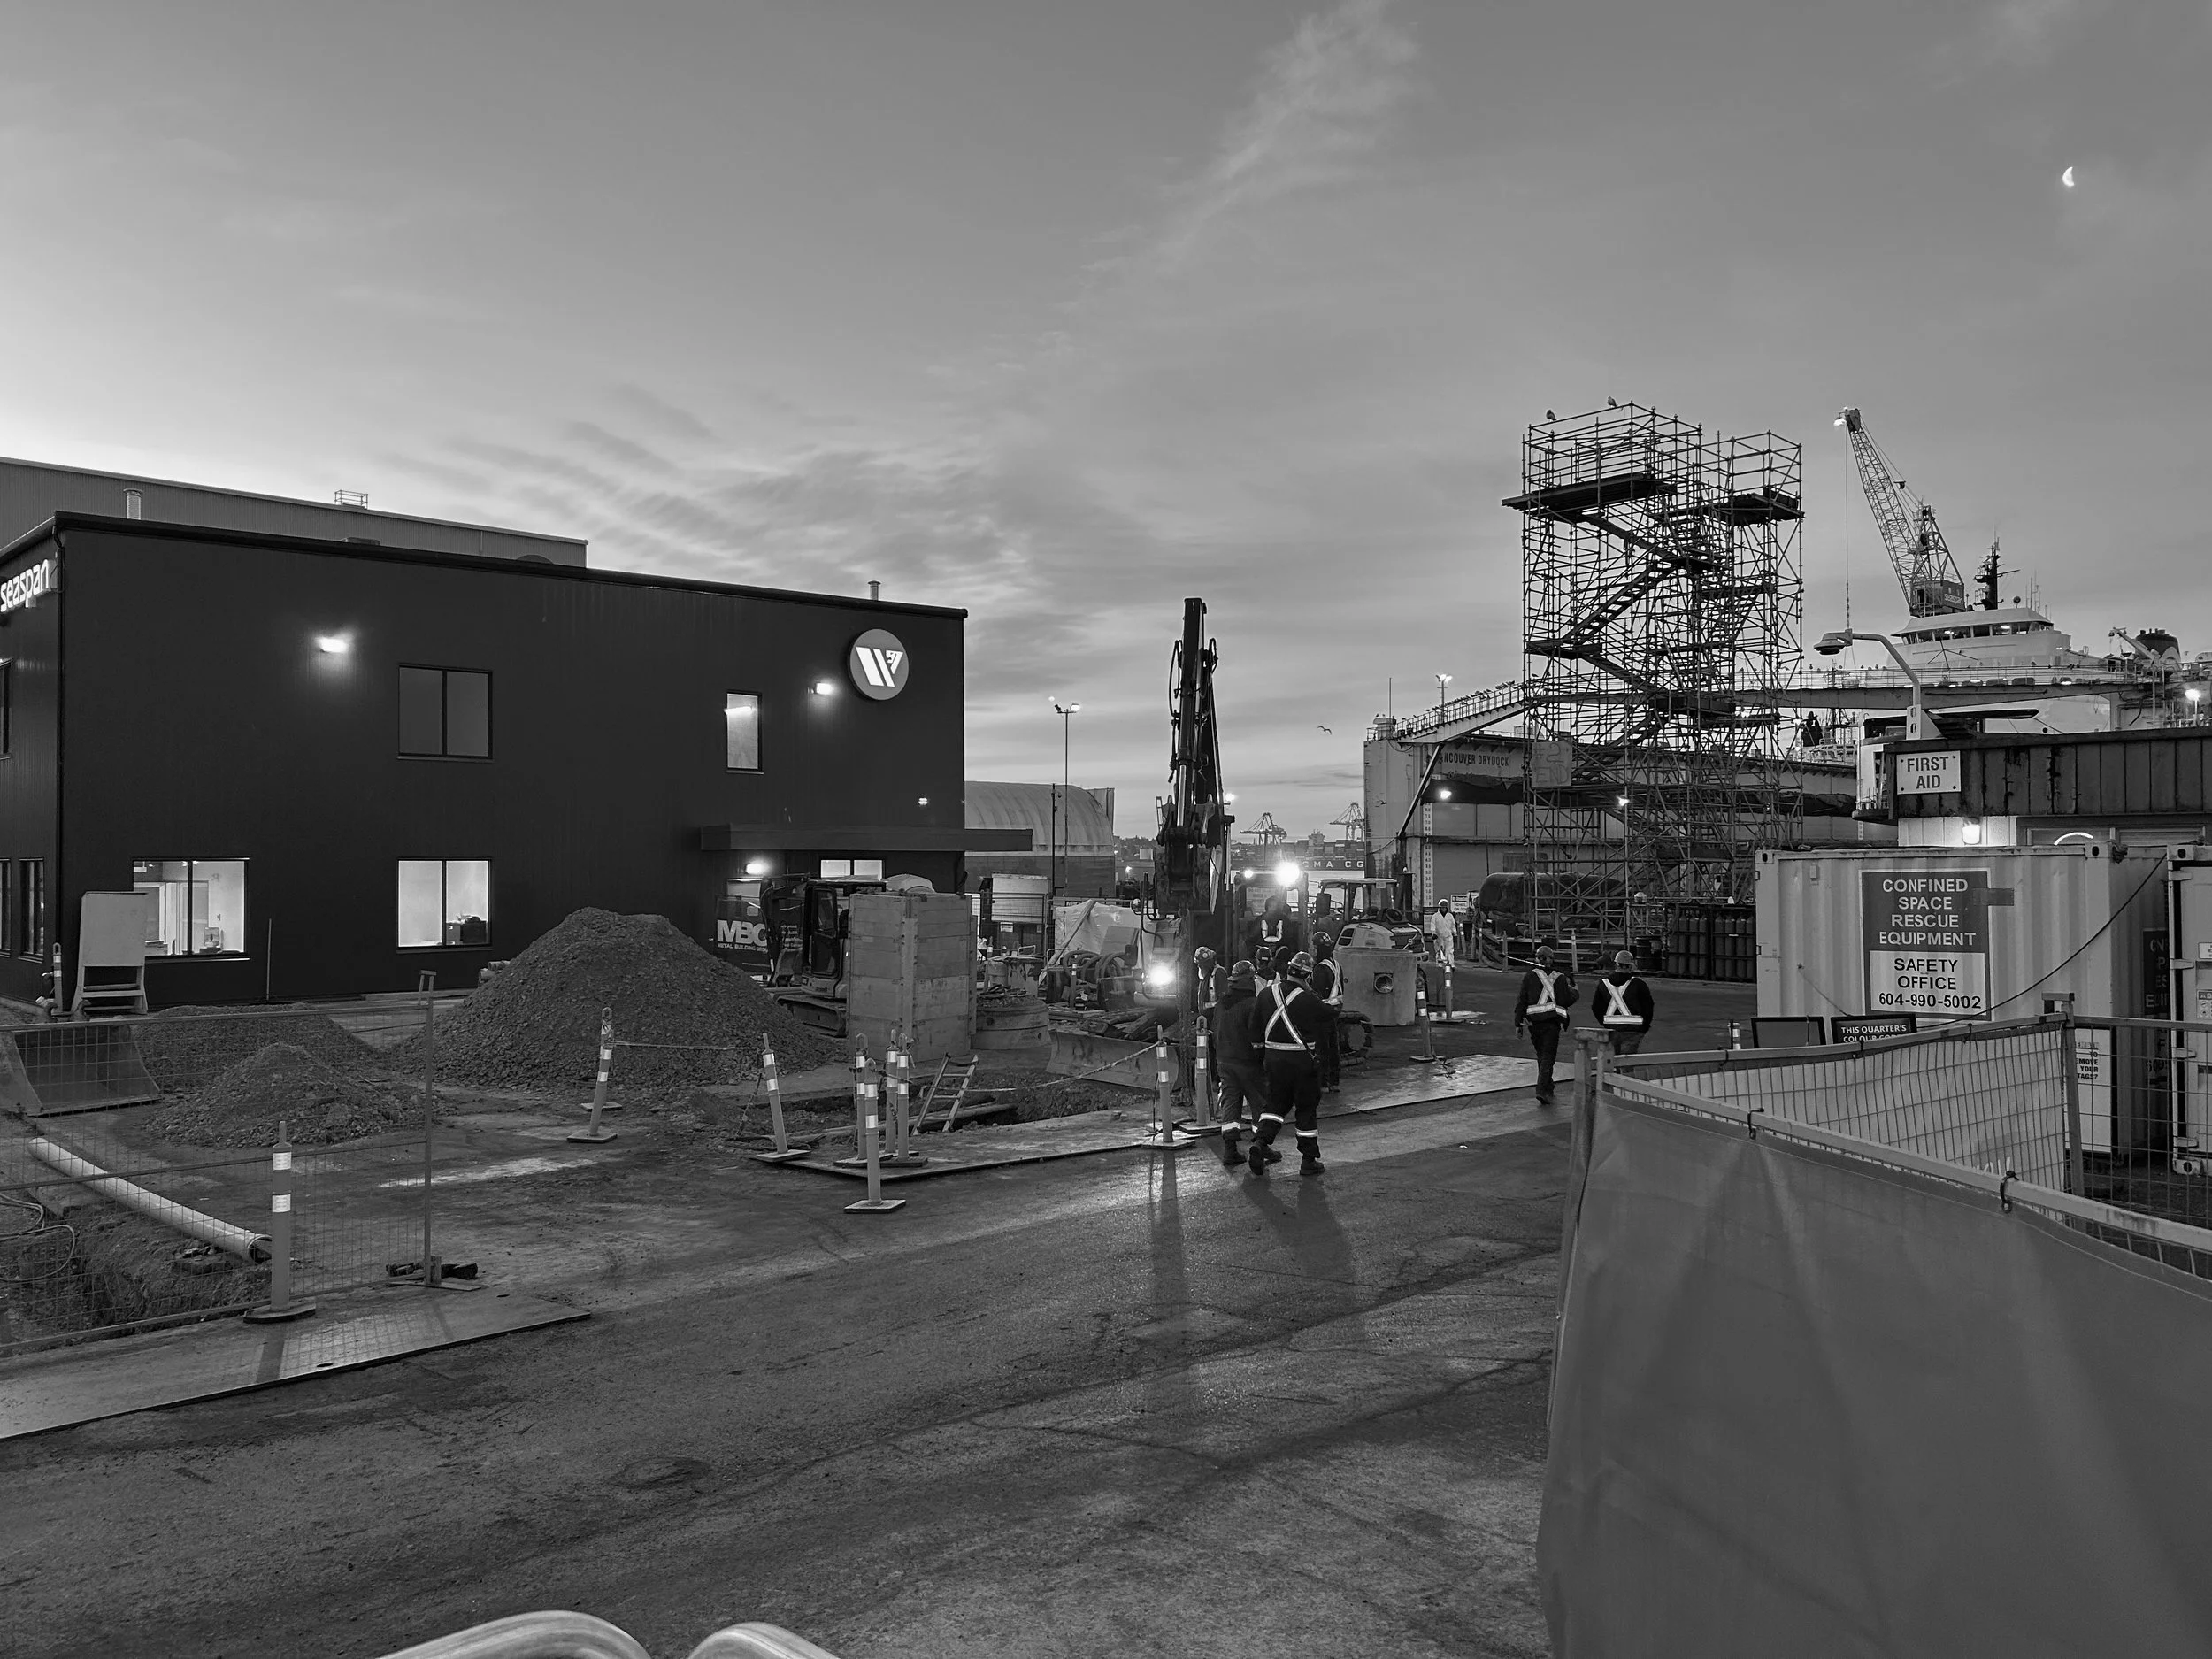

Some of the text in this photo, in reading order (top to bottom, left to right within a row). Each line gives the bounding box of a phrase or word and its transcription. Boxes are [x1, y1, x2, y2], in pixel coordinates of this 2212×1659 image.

[0, 558, 50, 612] seaspan
[1438, 751, 1509, 767] NCOUVER DRYDOCK
[1907, 757, 1948, 772] FIRST
[1916, 775, 1940, 789] AID
[1882, 879, 1969, 893] CONFINED
[1898, 896, 1953, 910] SPACE
[1891, 914, 1959, 928] RESCUE
[1879, 931, 1977, 946] EQUIPMENT
[1894, 958, 1958, 972] SAFETY
[1897, 976, 1957, 990] OFFICE
[1879, 992, 1982, 1010] 604-990-5002
[1861, 1025, 1907, 1033] QUARTER'S
